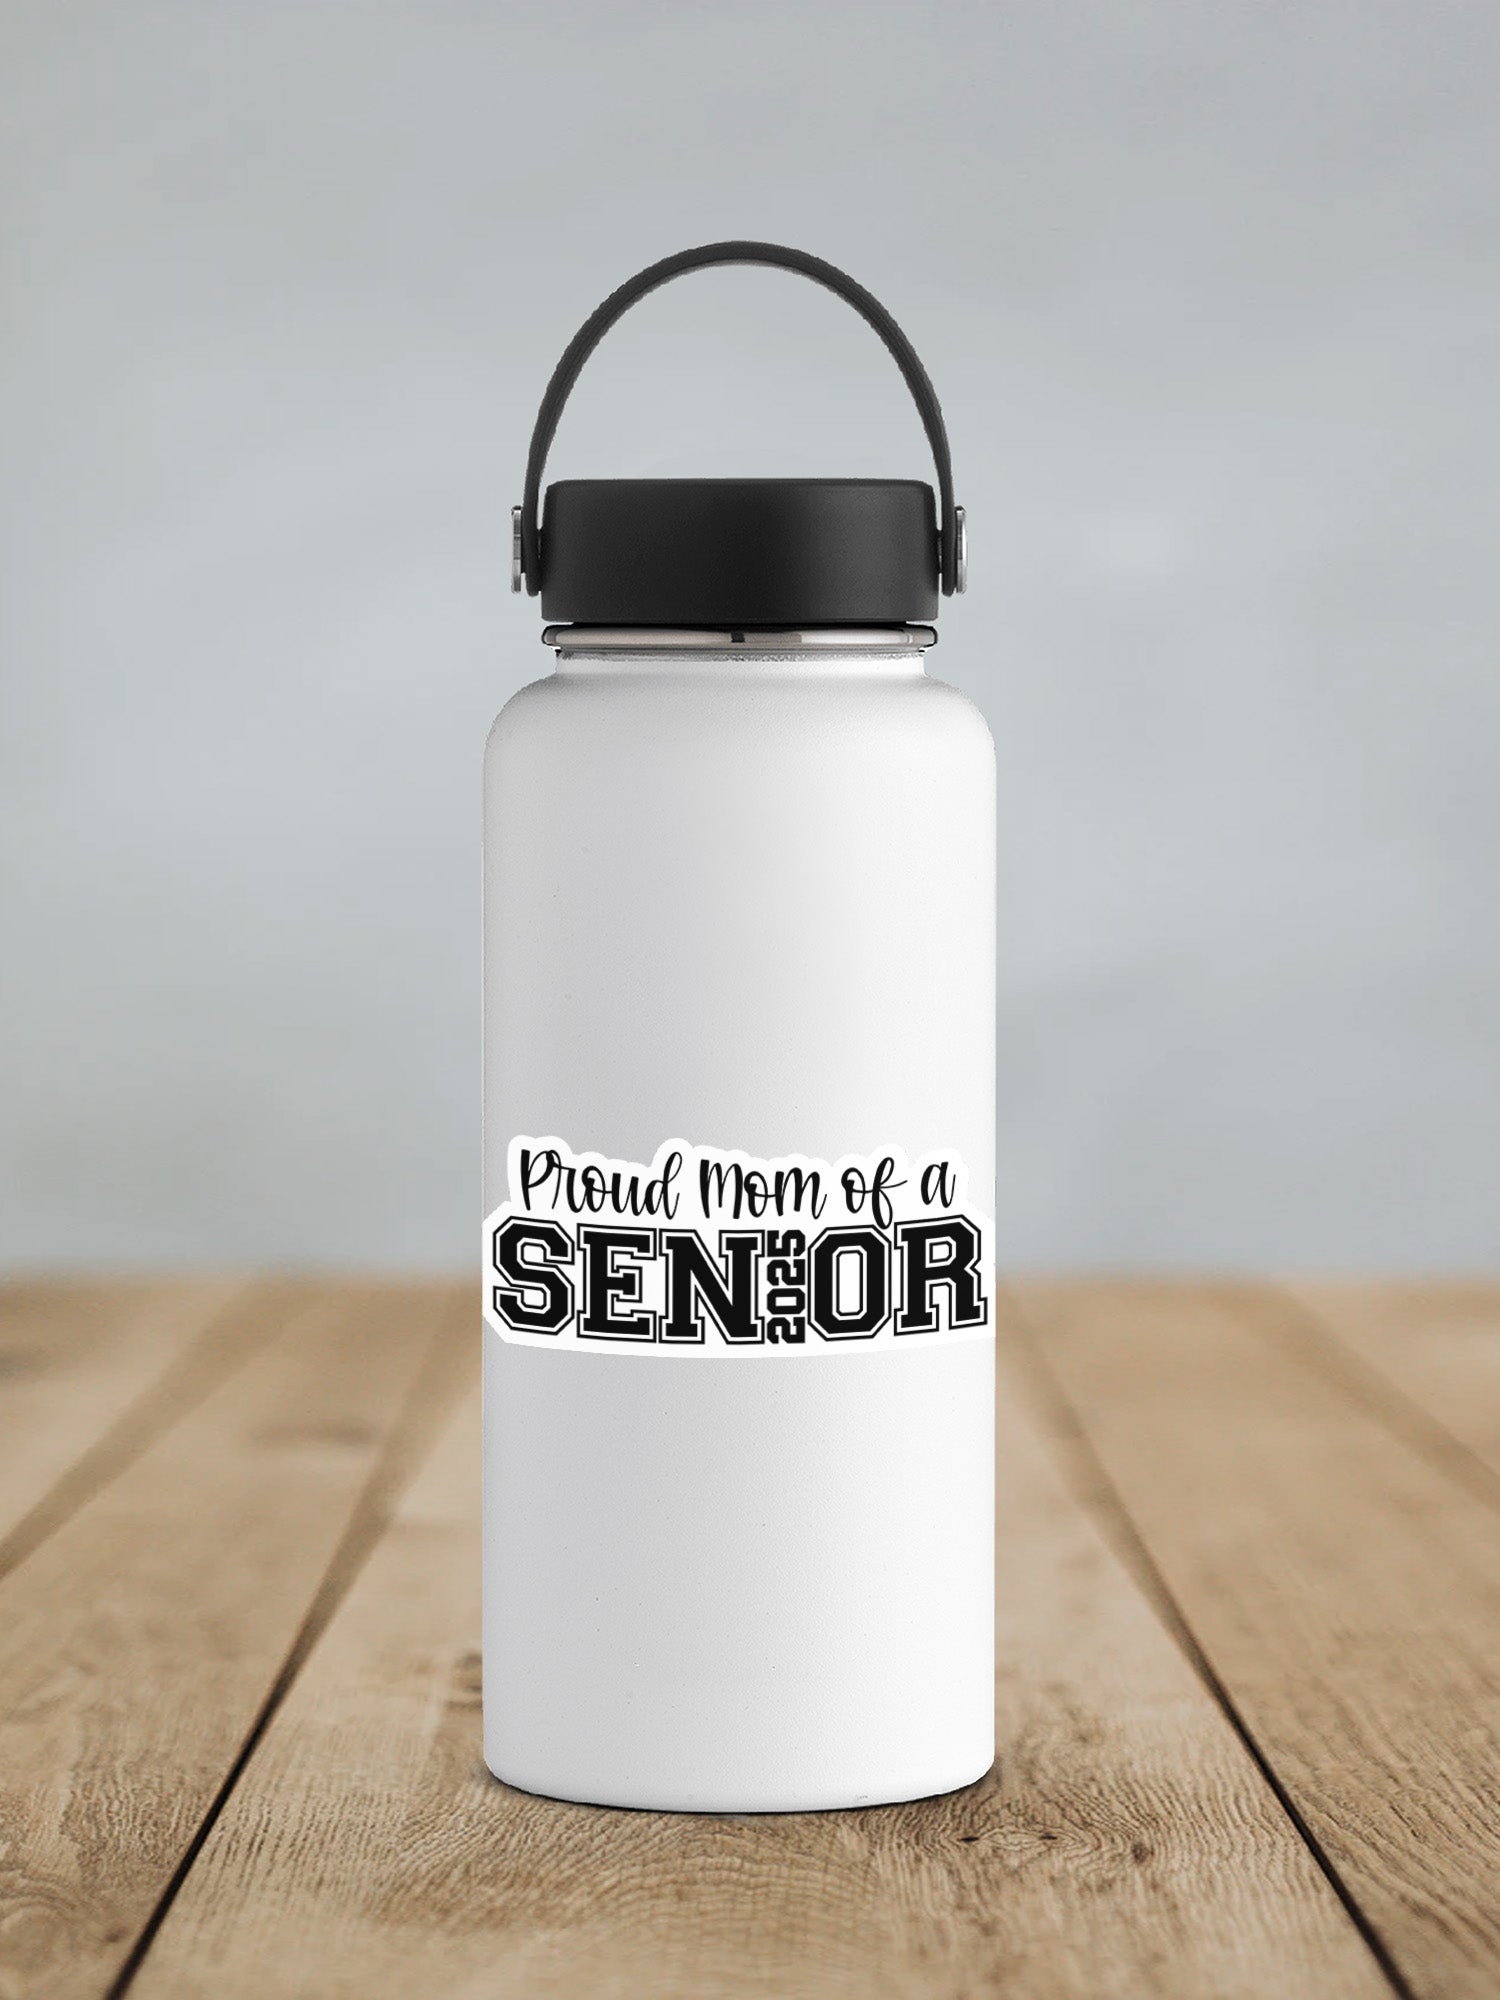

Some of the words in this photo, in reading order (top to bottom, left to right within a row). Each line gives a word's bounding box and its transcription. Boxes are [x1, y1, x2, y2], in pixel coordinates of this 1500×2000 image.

[521, 1149, 682, 1219] Proud
[700, 1159, 827, 1219] Mom
[841, 1157, 907, 1229] of
[921, 1161, 956, 1208] a
[767, 1230, 805, 1344] 2025
